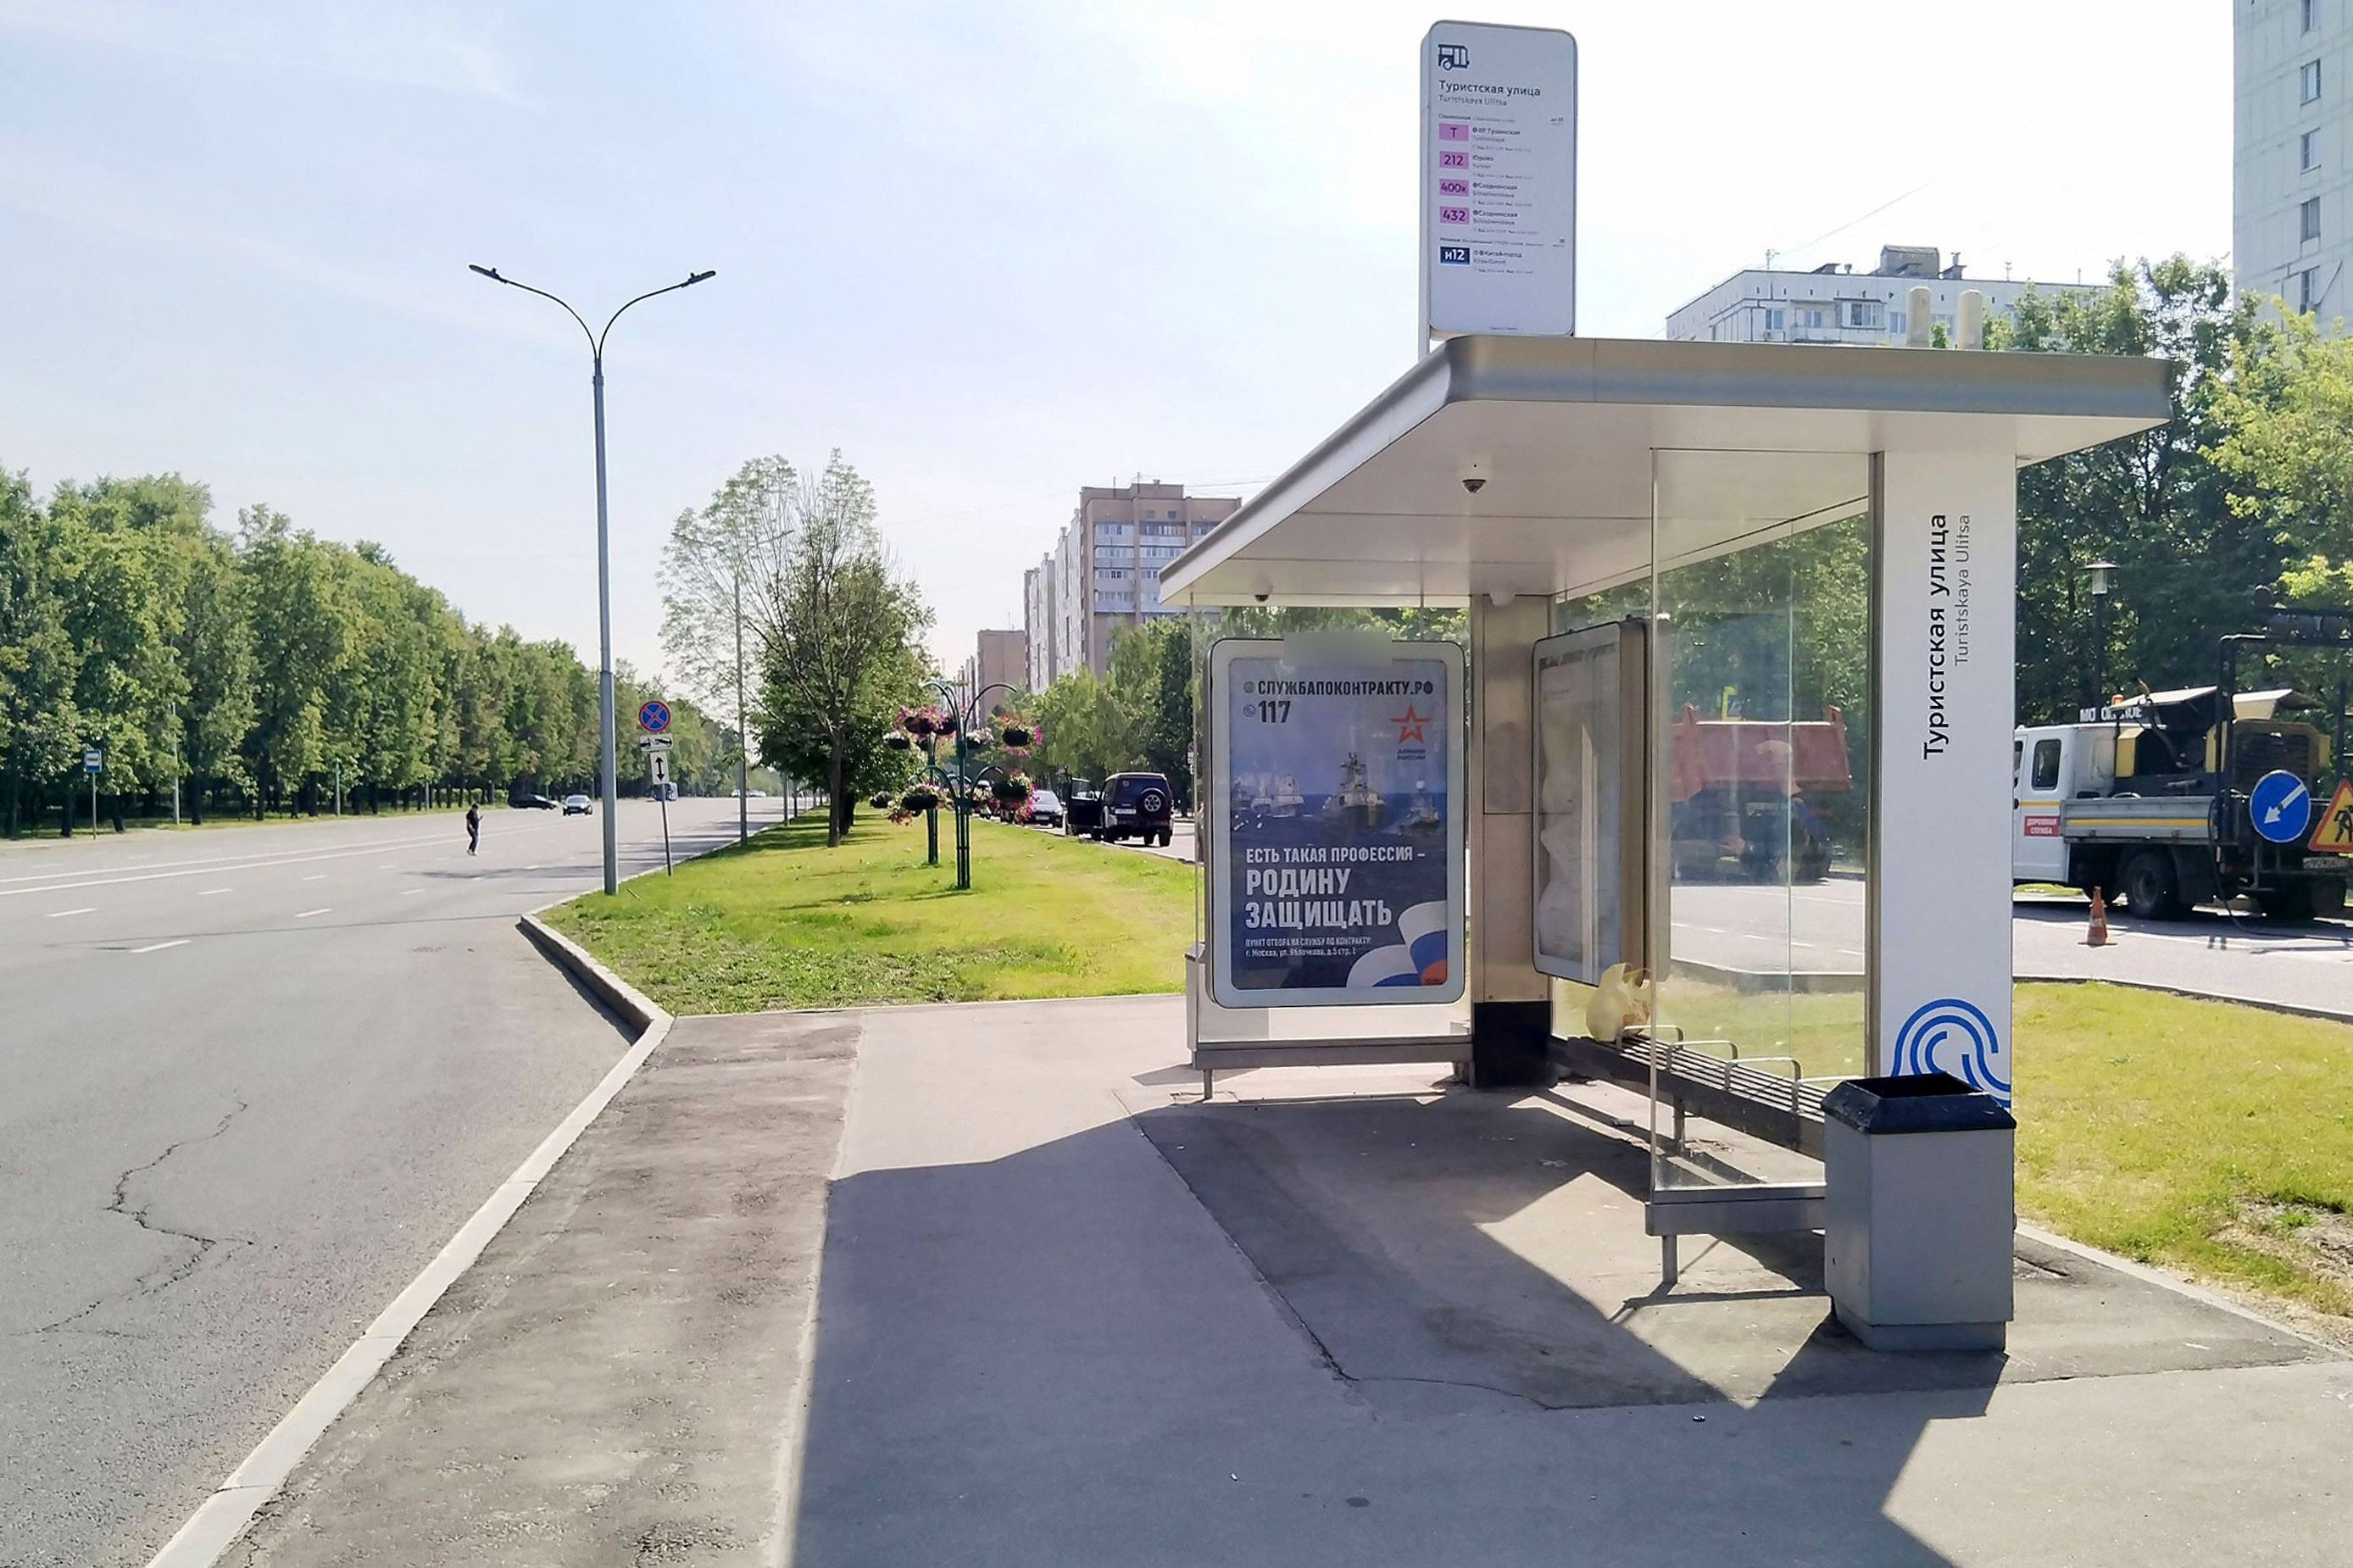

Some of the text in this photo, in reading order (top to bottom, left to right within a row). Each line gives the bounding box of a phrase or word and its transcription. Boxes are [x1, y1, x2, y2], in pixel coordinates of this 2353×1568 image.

[1438, 80, 1541, 97] Туристская улица
[1444, 154, 1464, 166] 212
[1443, 209, 1466, 221] 432
[1955, 514, 1972, 666] Turistskaya Ulitsa
[1923, 514, 1950, 759] Туристская улица
[1258, 681, 1434, 696] СЛУЖБАПОКОНТРАКТУ.РФ
[1258, 700, 1291, 723] 117
[1245, 848, 1280, 864] ЕСТЬ
[1283, 848, 1327, 863] ТАКАЯ
[1331, 846, 1413, 862] ПРОФЕССИЯ
[1246, 867, 1351, 898] РОДИНУ
[1244, 900, 1393, 930] ЗАЩИЩАТЬ
